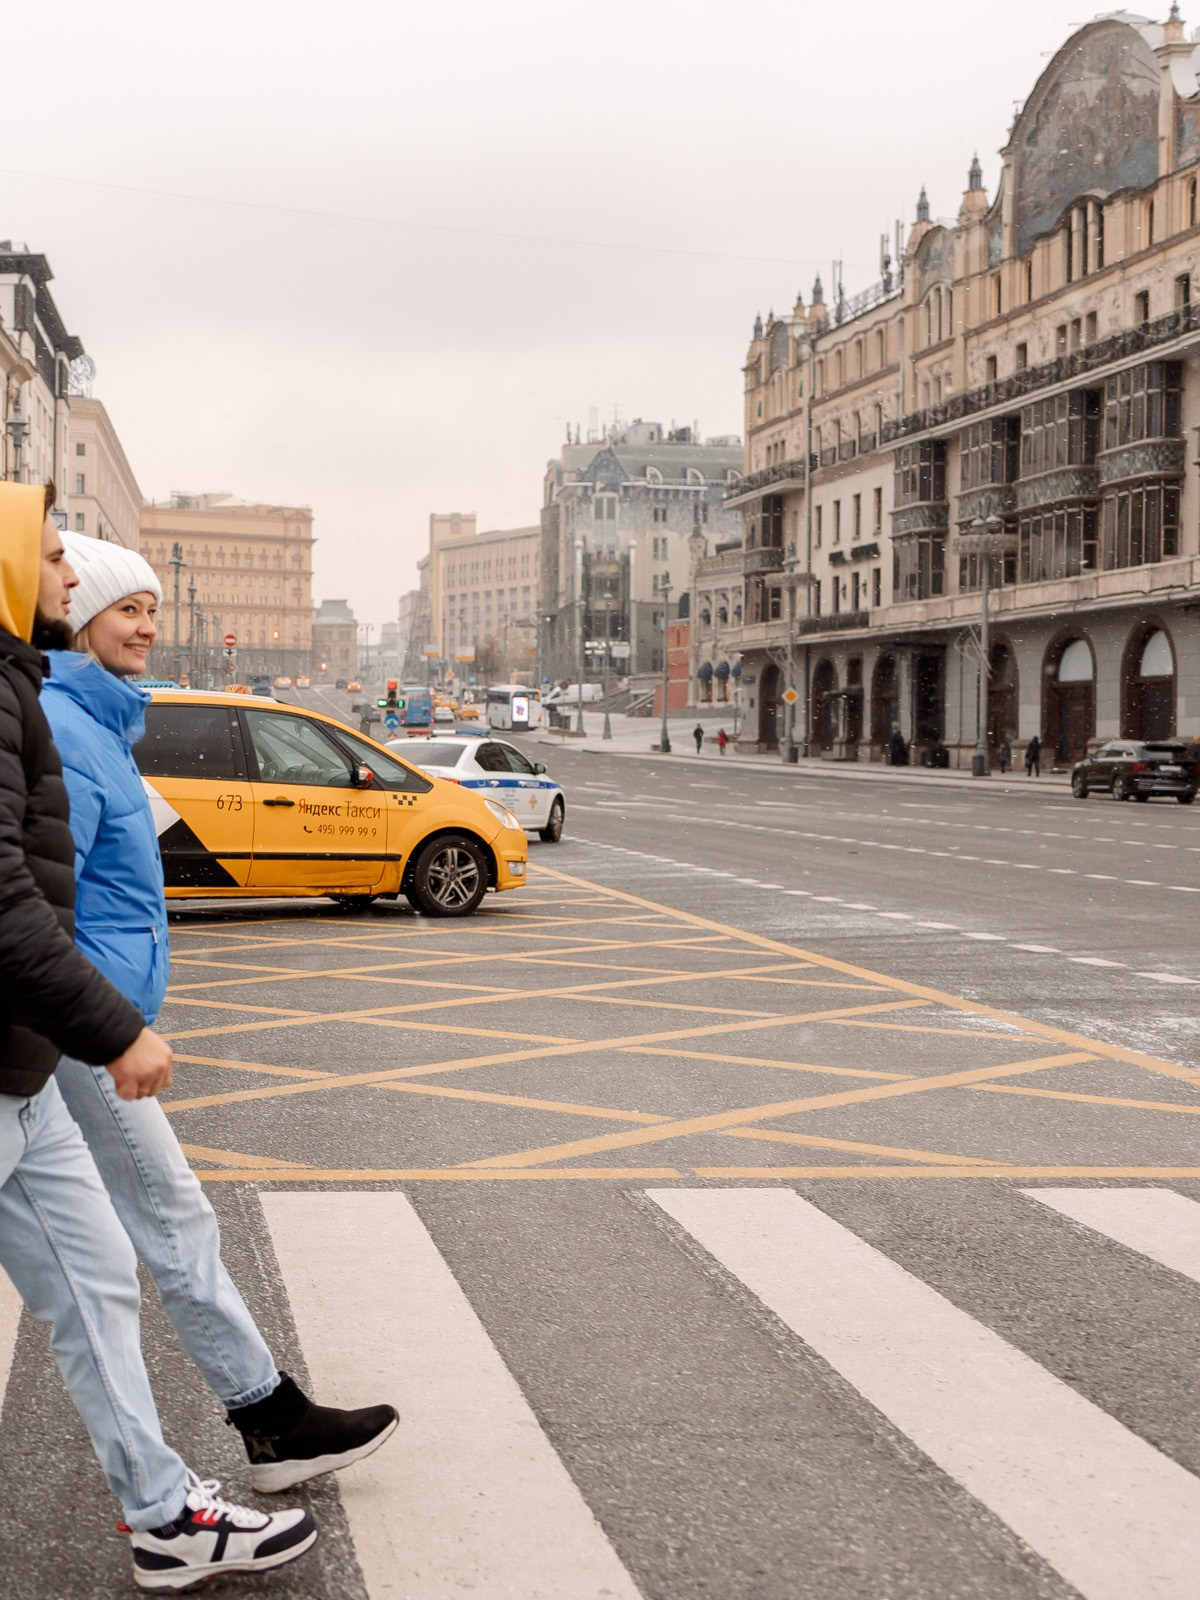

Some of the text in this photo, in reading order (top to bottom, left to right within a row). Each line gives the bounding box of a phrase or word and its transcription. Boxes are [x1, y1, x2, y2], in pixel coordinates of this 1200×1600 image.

[216, 794, 243, 812] 673
[298, 798, 381, 819] Яндекс Такси
[317, 824, 335, 836] 495)
[339, 825, 355, 836] 999
[358, 826, 369, 837] 99
